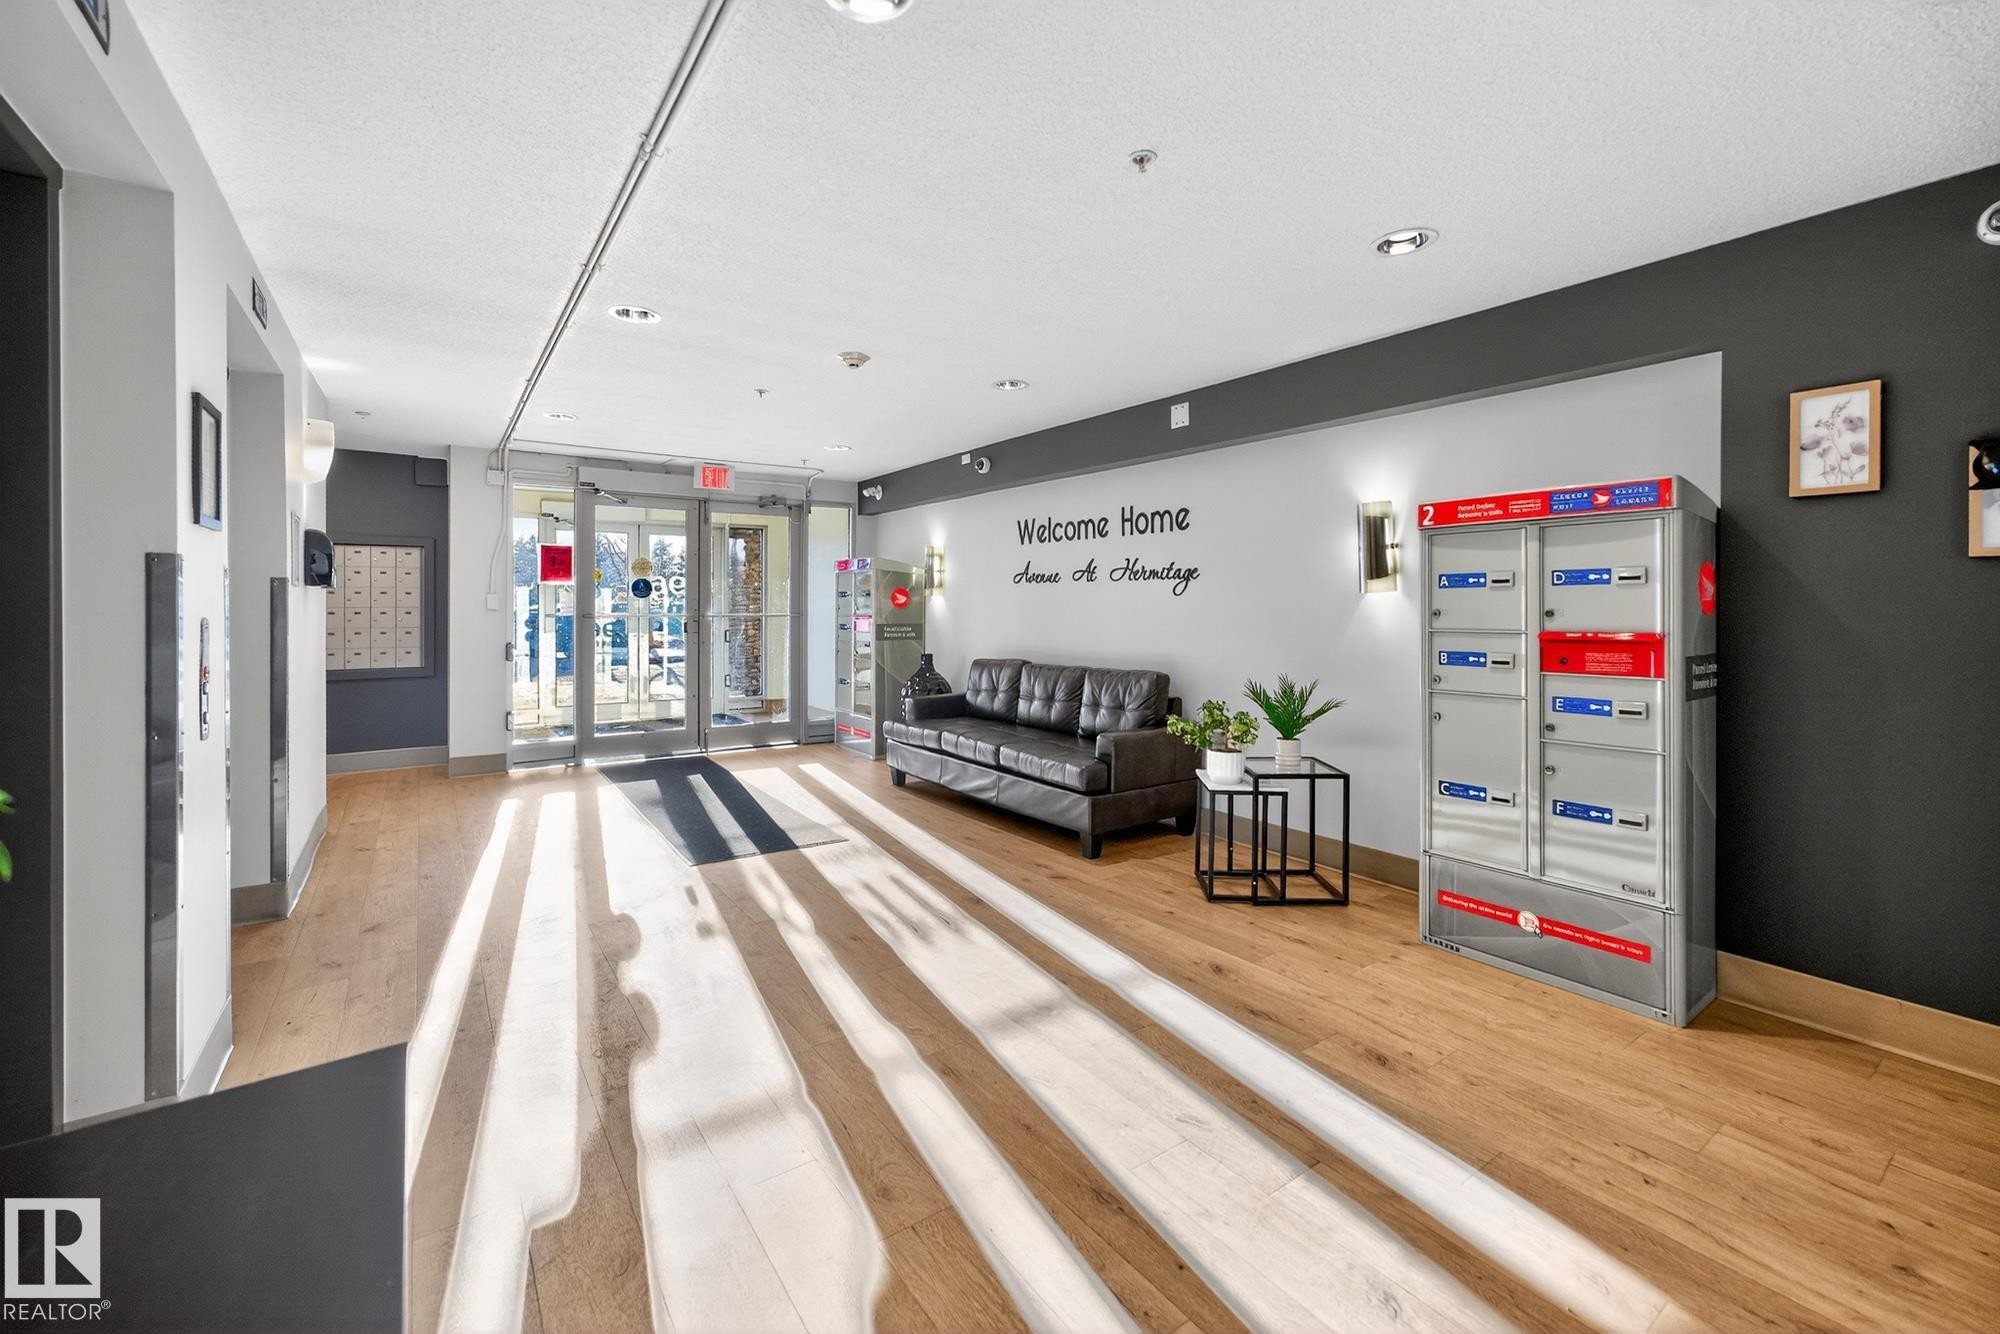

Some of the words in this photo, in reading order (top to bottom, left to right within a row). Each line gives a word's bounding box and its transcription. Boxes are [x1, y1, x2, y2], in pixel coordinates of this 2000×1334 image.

[1422, 505, 1435, 526] 2
[1017, 516, 1110, 546] Welcome
[1121, 505, 1190, 537] Home
[1072, 558, 1098, 583] At
[1109, 557, 1201, 597] Hermitage
[1440, 575, 1449, 587] A
[1553, 571, 1566, 584] D
[1440, 652, 1448, 664] B
[1555, 698, 1564, 711] E
[1440, 782, 1450, 795] C
[1556, 802, 1565, 814] F
